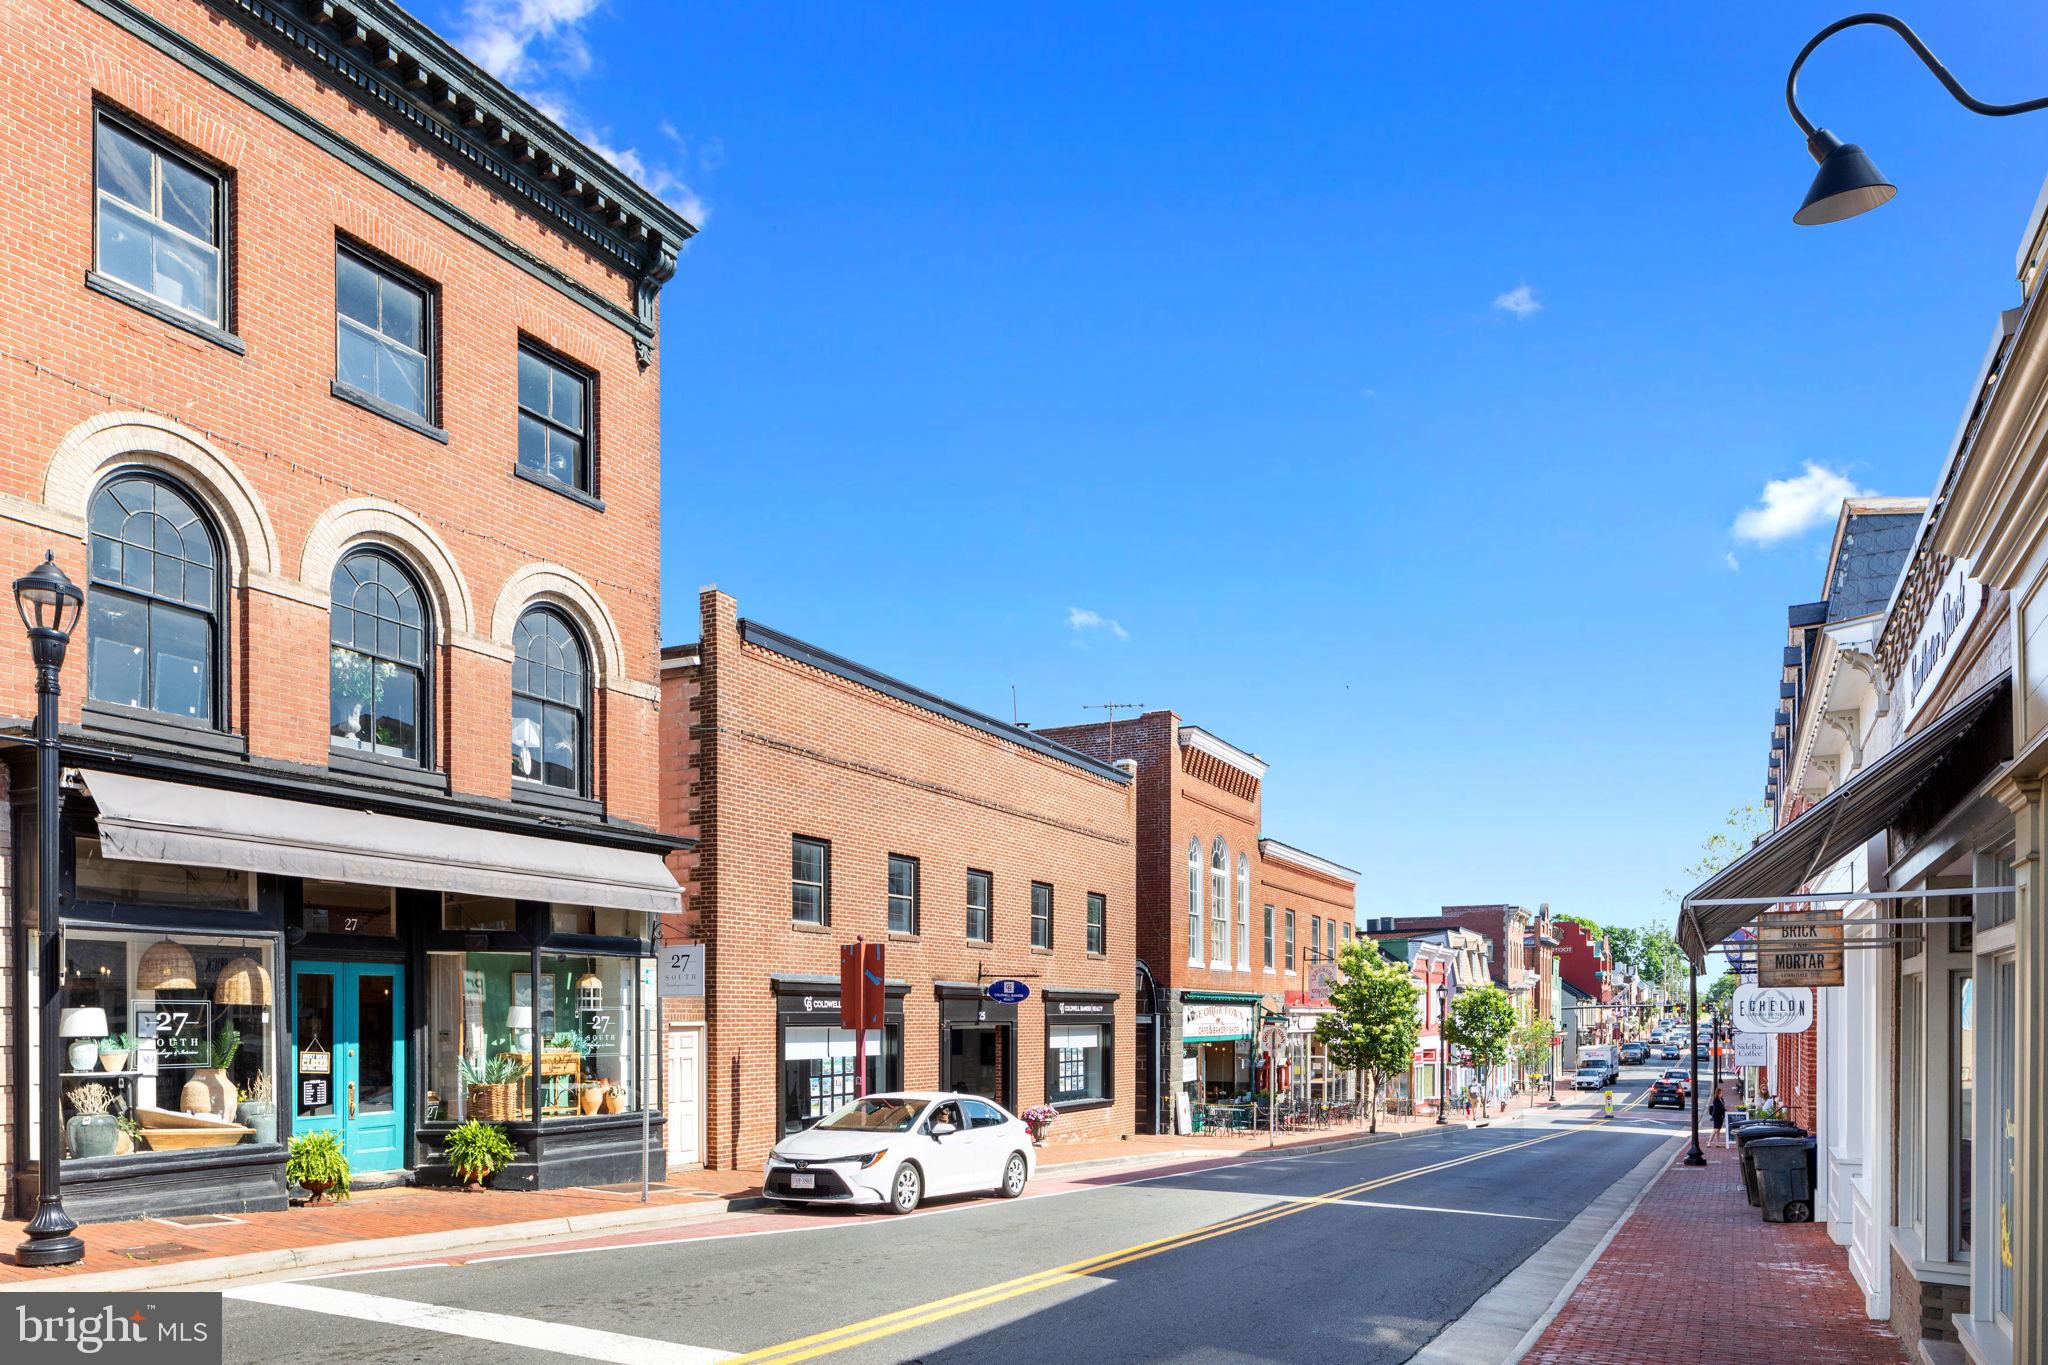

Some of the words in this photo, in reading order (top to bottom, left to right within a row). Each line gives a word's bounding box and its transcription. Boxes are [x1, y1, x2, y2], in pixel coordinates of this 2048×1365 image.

[344, 918, 358, 931] 27
[1781, 924, 1818, 938] BRICK
[671, 954, 691, 972] 27
[1775, 953, 1825, 970] MORTAR
[813, 1000, 842, 1009] COLDWELL
[1740, 1000, 1805, 1016] ECHELON
[978, 1011, 986, 1021] 25
[156, 1012, 189, 1036] 27
[591, 1015, 611, 1034] 27
[157, 1038, 199, 1047] OUTH
[1738, 1049, 1762, 1057] Coffee
